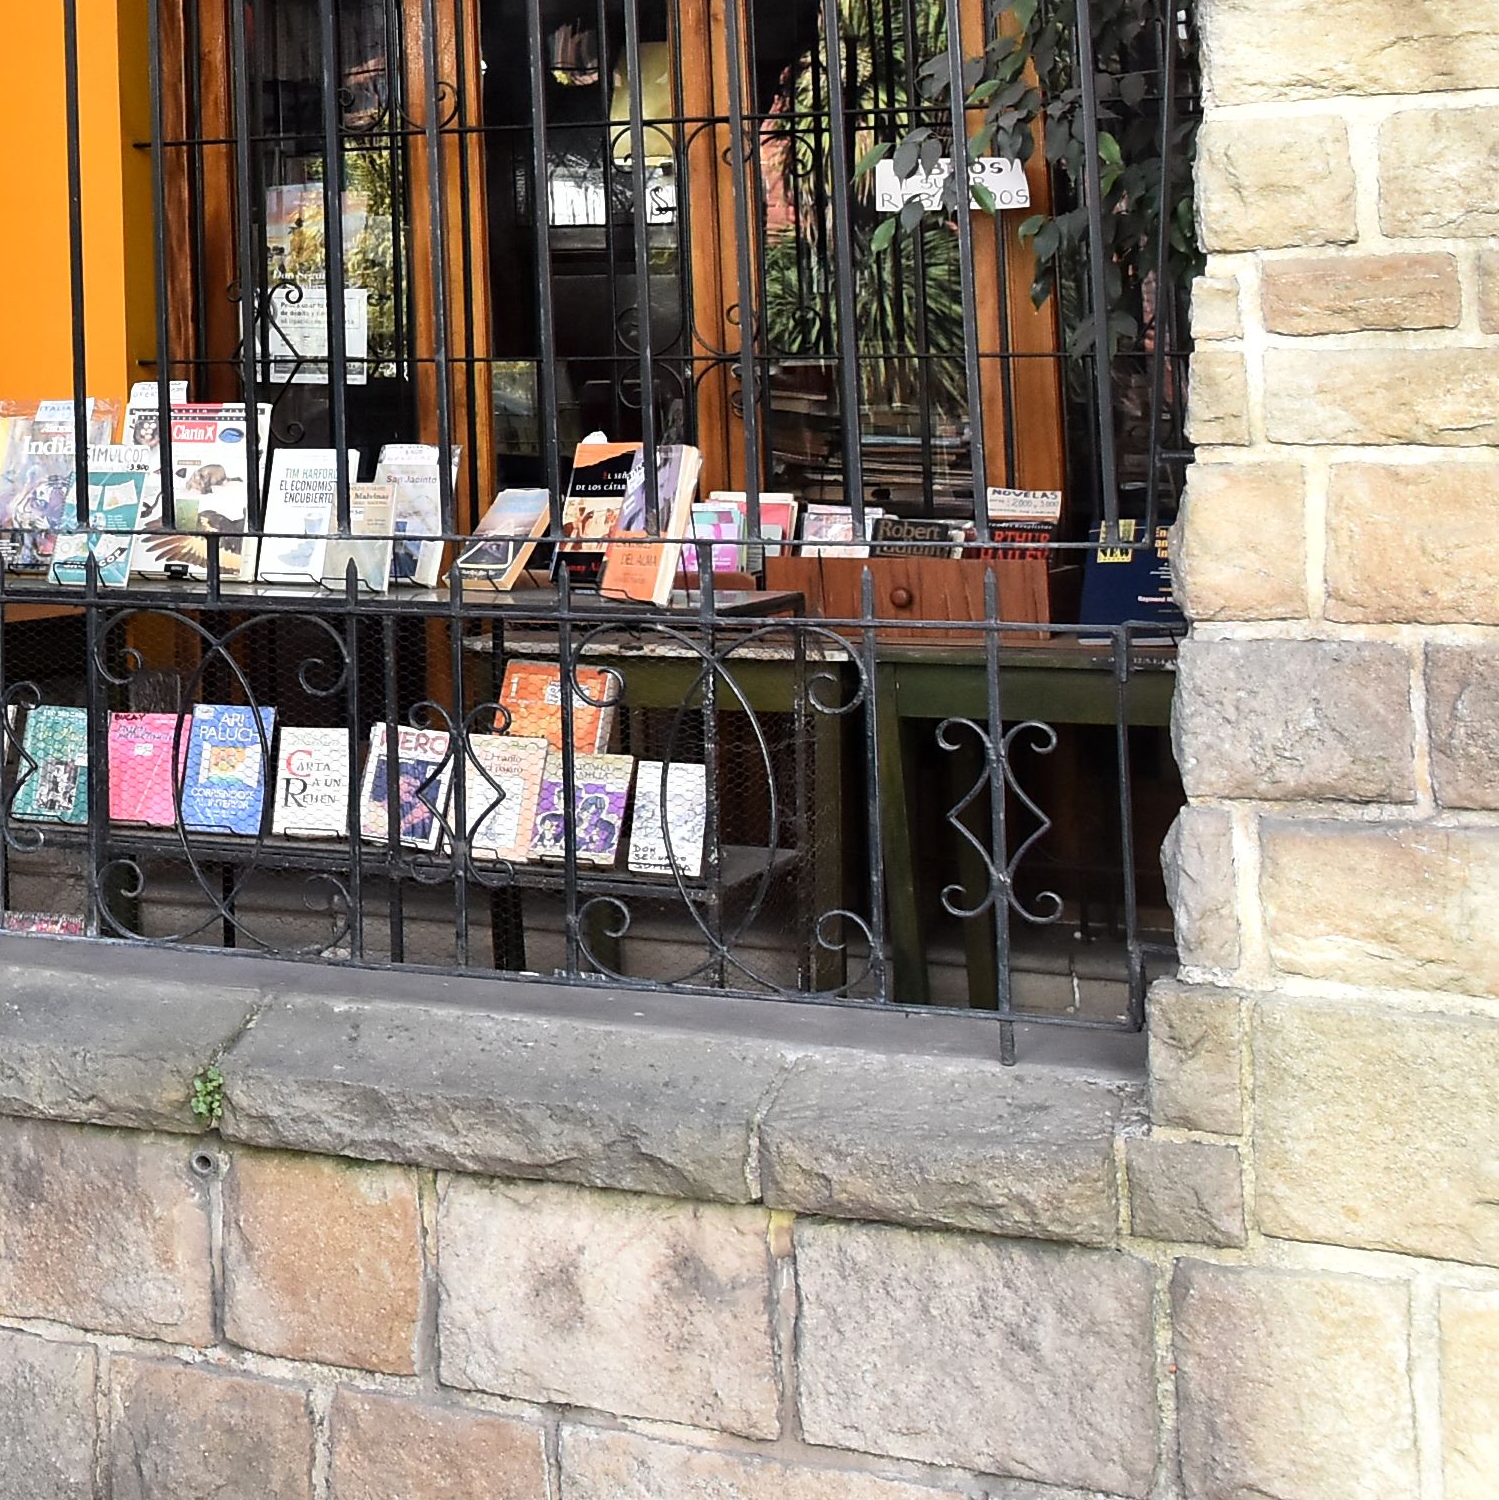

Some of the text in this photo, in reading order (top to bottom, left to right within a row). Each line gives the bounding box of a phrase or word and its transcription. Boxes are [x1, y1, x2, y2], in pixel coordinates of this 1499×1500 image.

[285, 468, 299, 479] TIM
[279, 480, 288, 491] EL
[992, 489, 1058, 500] NOVELAS
[879, 521, 941, 541] Robert
[995, 531, 1050, 543] RTHUR
[286, 750, 330, 777] CARTA
[324, 778, 342, 788] UN
[633, 845, 656, 853] DON
